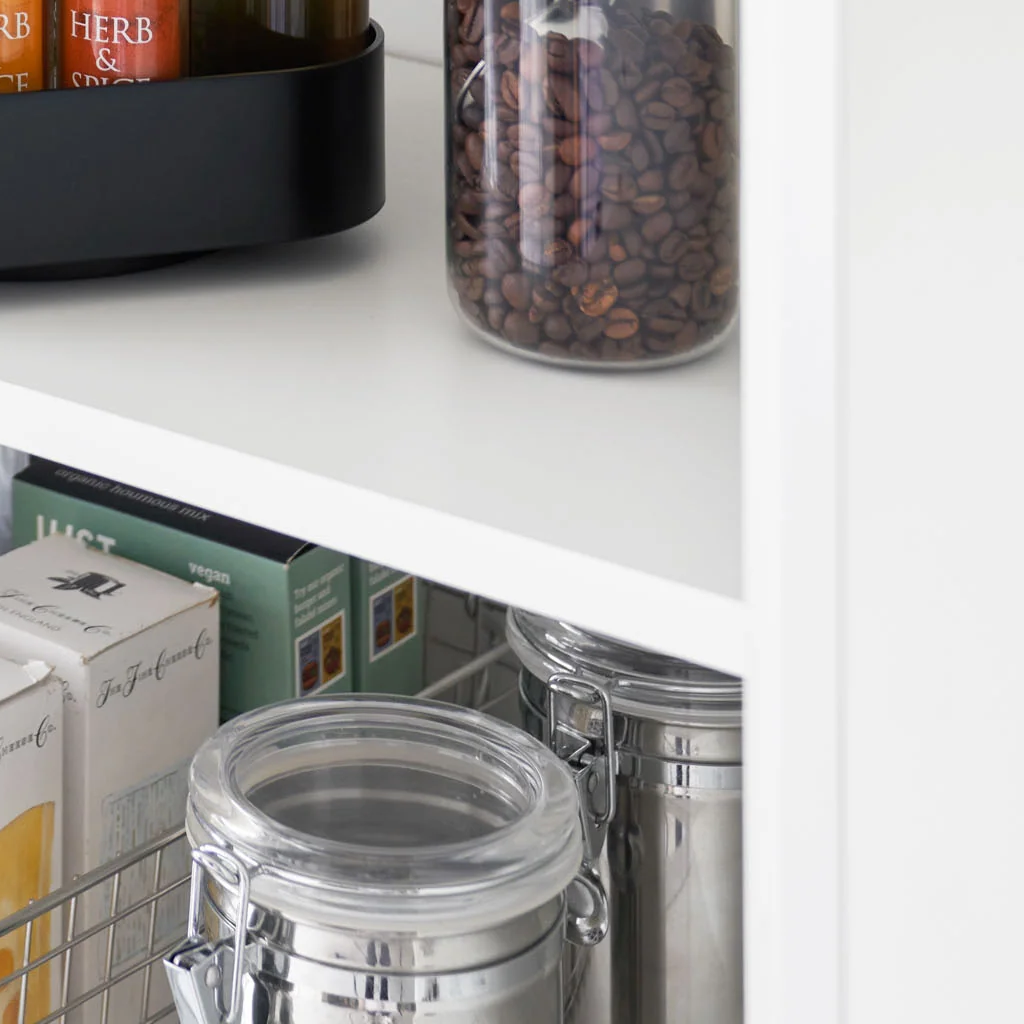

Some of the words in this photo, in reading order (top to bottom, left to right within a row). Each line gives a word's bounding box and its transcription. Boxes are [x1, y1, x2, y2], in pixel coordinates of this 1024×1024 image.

[70, 9, 154, 45] HERB
[95, 47, 121, 73] &
[54, 468, 110, 492] organic
[109, 483, 179, 513] houmous
[179, 505, 212, 522] mix
[188, 561, 231, 585] vegan
